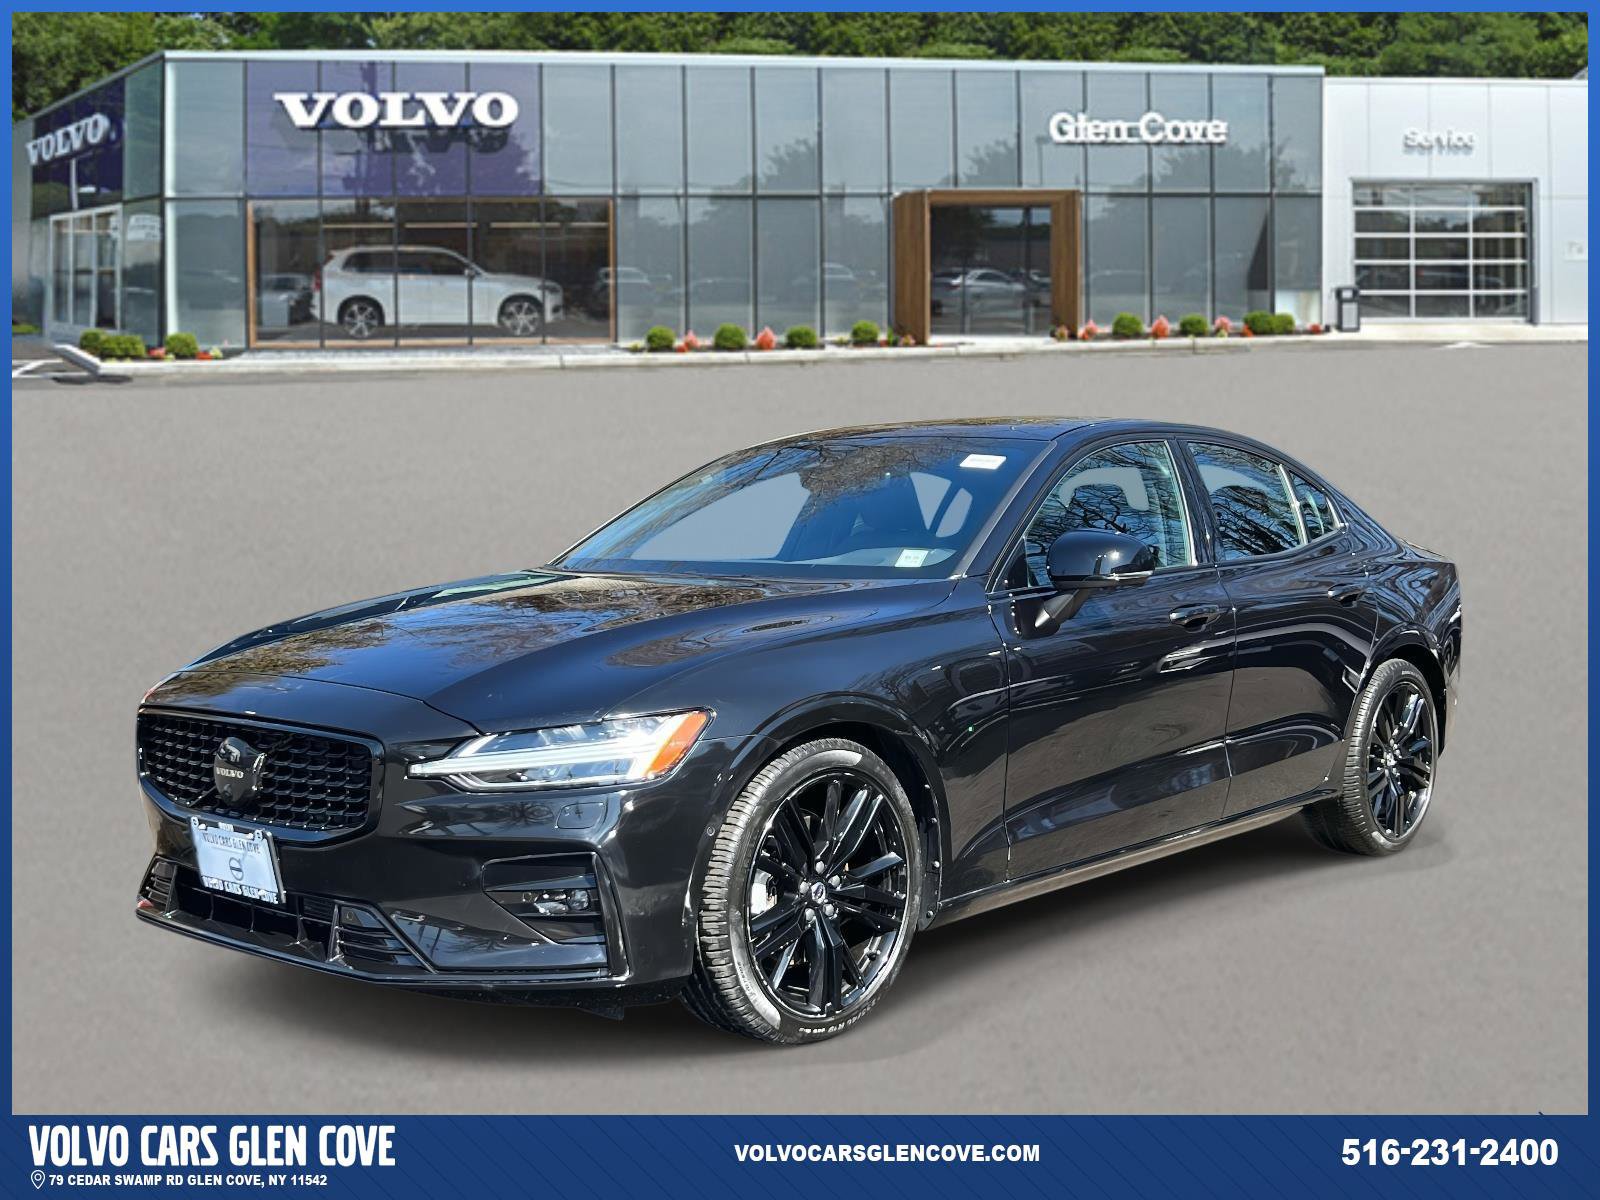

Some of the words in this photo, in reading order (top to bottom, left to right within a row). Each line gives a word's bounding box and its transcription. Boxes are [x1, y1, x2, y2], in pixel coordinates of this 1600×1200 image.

[274, 92, 519, 127] VOLVO
[26, 113, 110, 165] VOLVO
[1049, 112, 1129, 143] Glen
[1139, 112, 1228, 143] Cove
[1402, 128, 1476, 155] Service
[215, 766, 244, 779] VOLVO
[202, 833, 219, 845] VOLVO
[218, 836, 233, 848] CARS
[232, 838, 246, 851] GLEN
[246, 841, 261, 854] COVE
